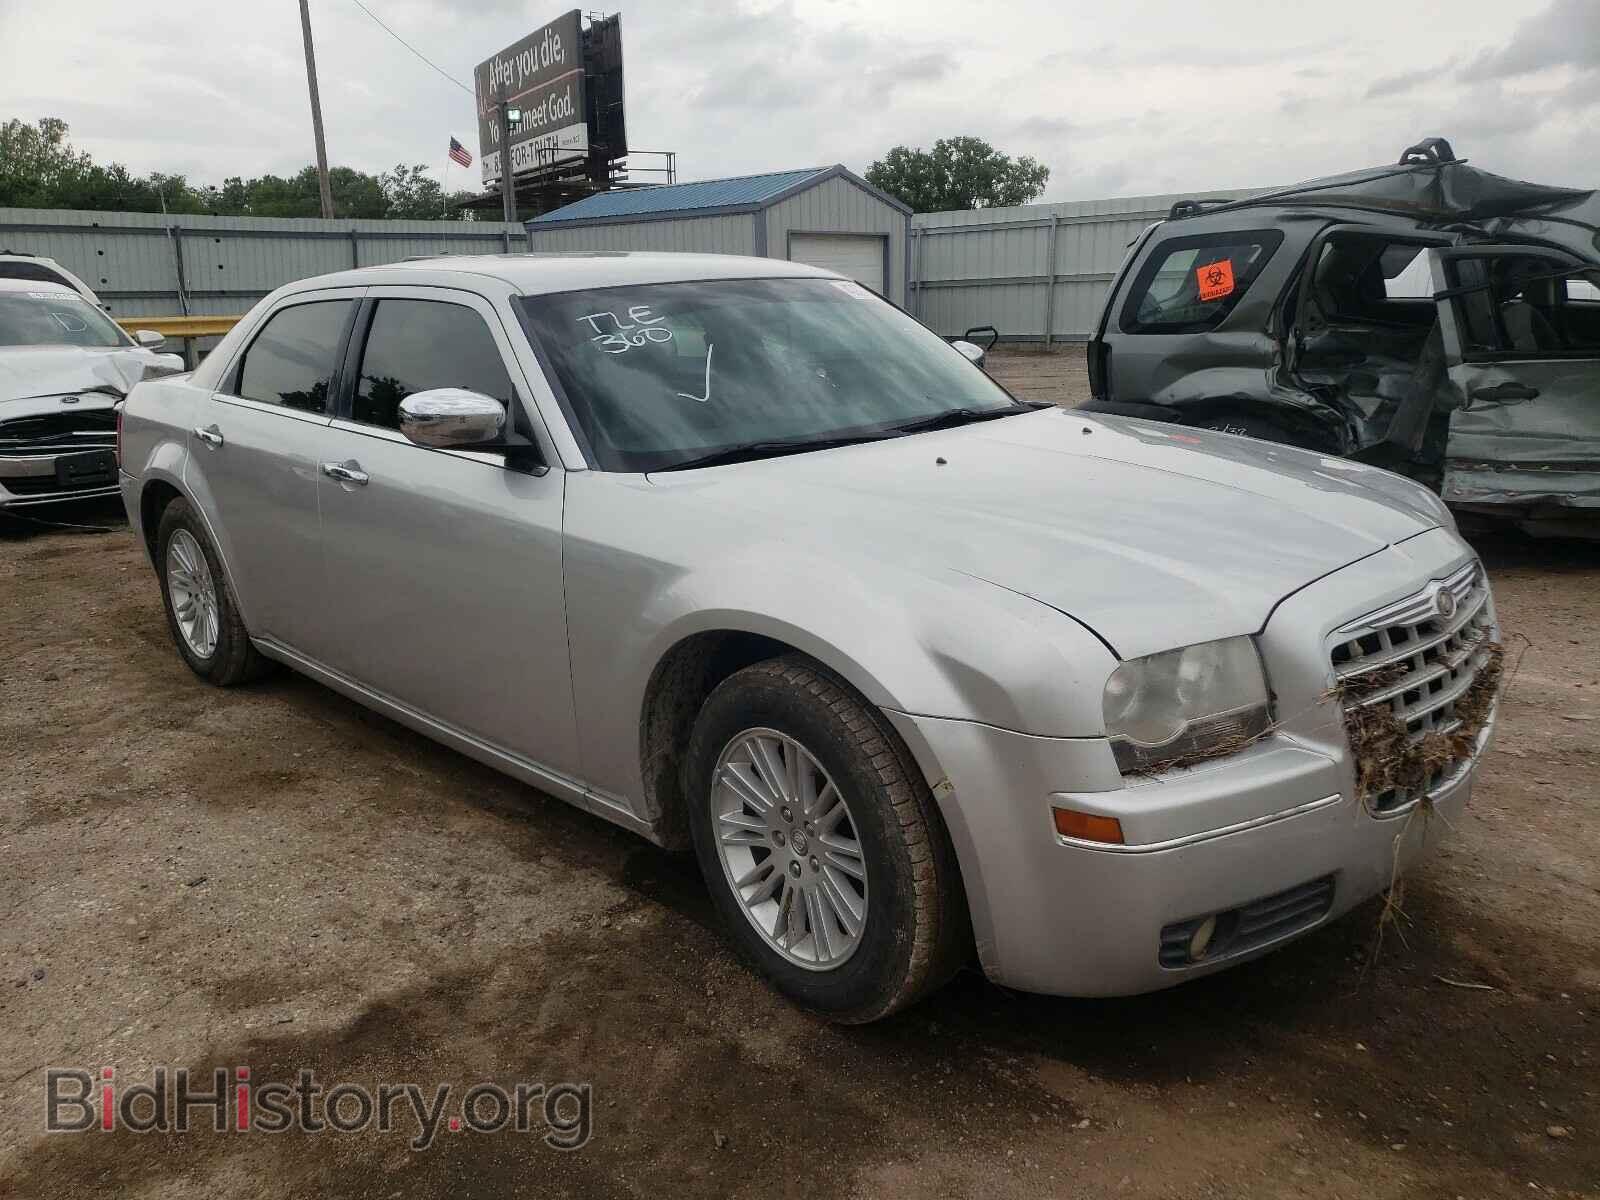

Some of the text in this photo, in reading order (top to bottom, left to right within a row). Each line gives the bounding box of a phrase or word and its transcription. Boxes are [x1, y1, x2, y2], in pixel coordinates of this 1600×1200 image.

[489, 28, 565, 95] After you die,
[488, 119, 500, 144] Yo
[523, 99, 548, 132] meet
[549, 84, 574, 121] God.
[591, 327, 673, 354] 360
